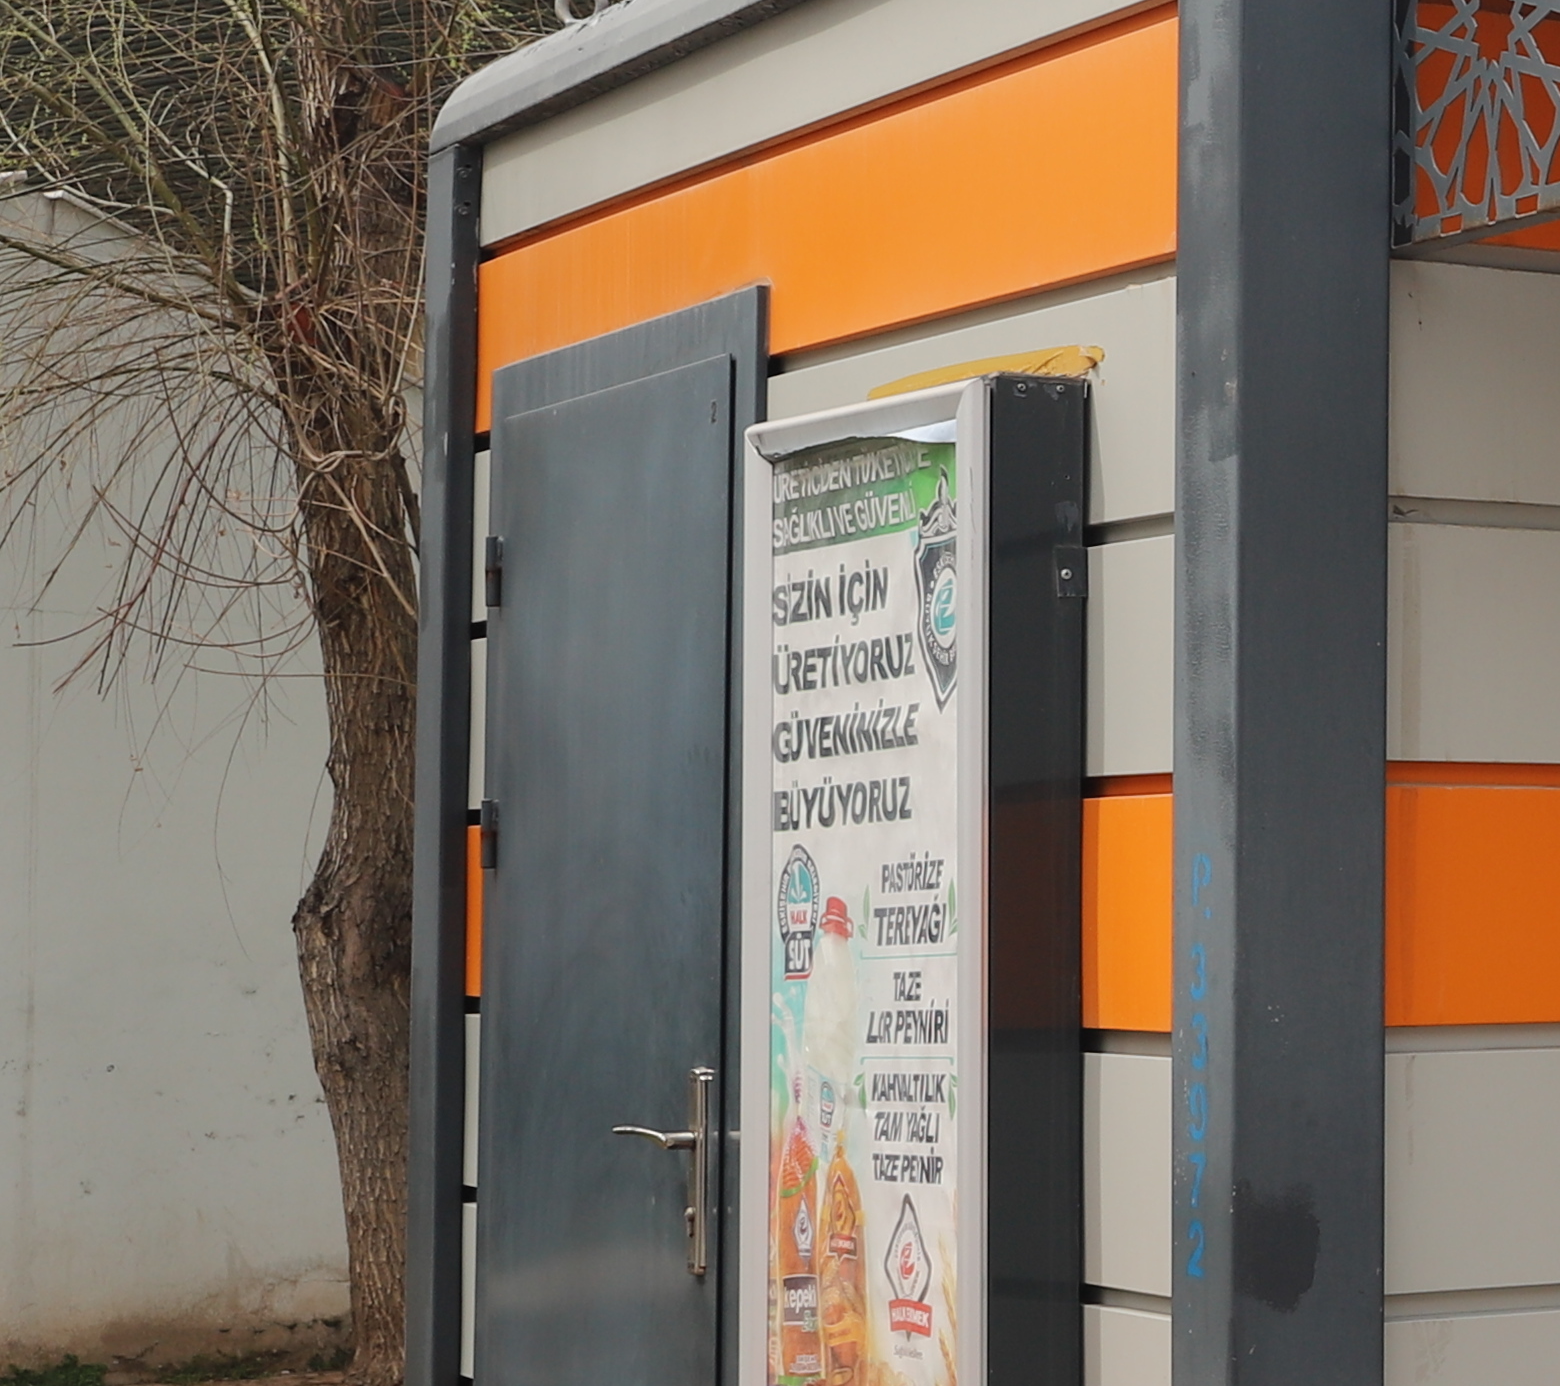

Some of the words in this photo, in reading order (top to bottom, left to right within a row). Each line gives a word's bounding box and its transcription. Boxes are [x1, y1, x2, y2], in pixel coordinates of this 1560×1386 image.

[773, 569, 832, 626] SİZİN
[838, 558, 888, 626] İÇİN
[773, 631, 915, 695] ÜRETİYORUZ
[773, 698, 920, 763] GÜVENİNİZLE
[773, 776, 912, 832] BÜYÜYORUZ
[881, 850, 944, 894] PASTÖRİZE
[873, 893, 947, 946] TEREYAĞI
[893, 971, 922, 1001] TAZE
[893, 998, 949, 1044] PEYNİRİ
[874, 1111, 902, 1142] TAM
[905, 1105, 940, 1143] YAĞLI
[872, 1153, 901, 1182] TAZE
[900, 1146, 944, 1184] PENİR
